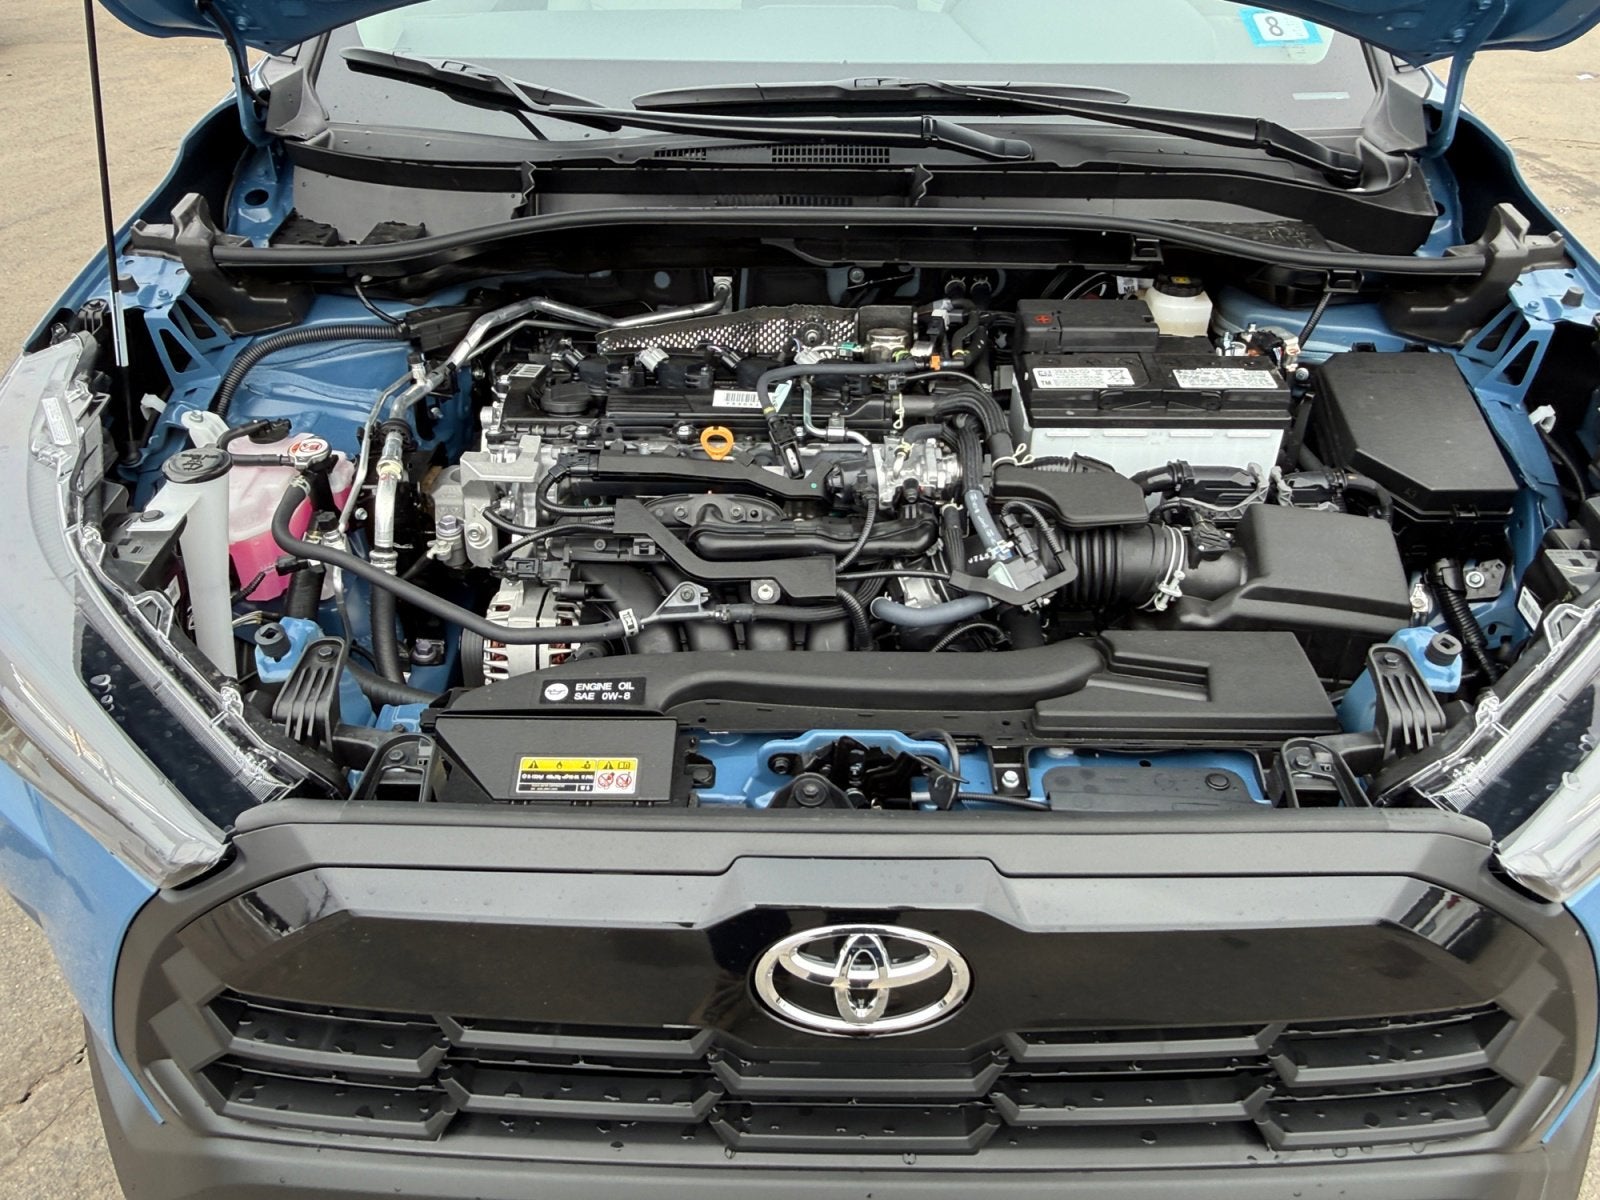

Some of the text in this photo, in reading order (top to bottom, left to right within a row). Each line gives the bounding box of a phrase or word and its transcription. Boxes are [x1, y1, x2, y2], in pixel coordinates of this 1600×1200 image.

[1264, 15, 1284, 37] 8
[575, 681, 635, 691] ENGINE OIL
[574, 691, 631, 701] SAE 0W-8
